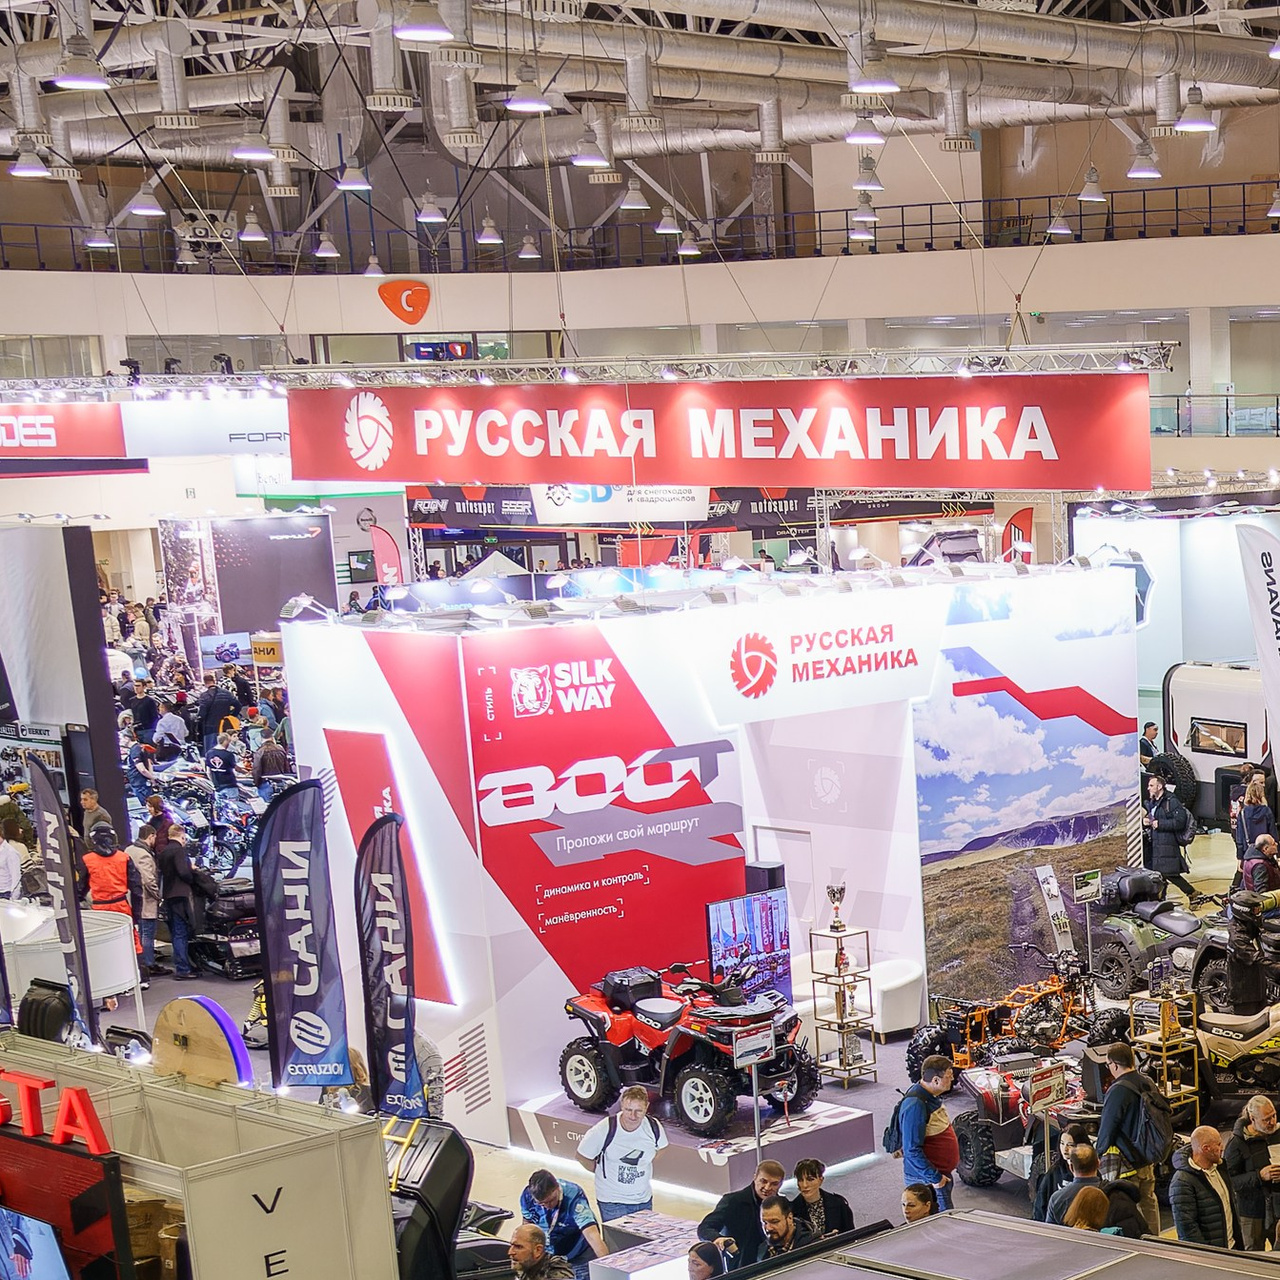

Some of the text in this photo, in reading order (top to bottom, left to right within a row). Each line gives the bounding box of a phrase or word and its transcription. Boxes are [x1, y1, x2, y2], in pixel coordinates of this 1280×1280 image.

[414, 406, 1059, 461] РУССКАЯ МЕХАНИКА
[454, 499, 495, 516] motosuper
[627, 488, 693, 497] для снегоходов
[637, 495, 696, 505] квадроциклов
[750, 498, 799, 515] motosuper
[790, 623, 895, 655] РУССКАЯ
[554, 658, 616, 689] SILK
[791, 648, 918, 682] МЕХАНИКА
[556, 682, 617, 713] WAY
[556, 817, 700, 852] Проложи свой маршрут
[543, 880, 591, 899] динамика
[601, 869, 644, 889] контроль
[279, 840, 321, 996] САНИ
[544, 904, 618, 927] манёвренность
[1211, 1027, 1244, 1040] 800
[287, 1061, 344, 1076] EXTRUZION
